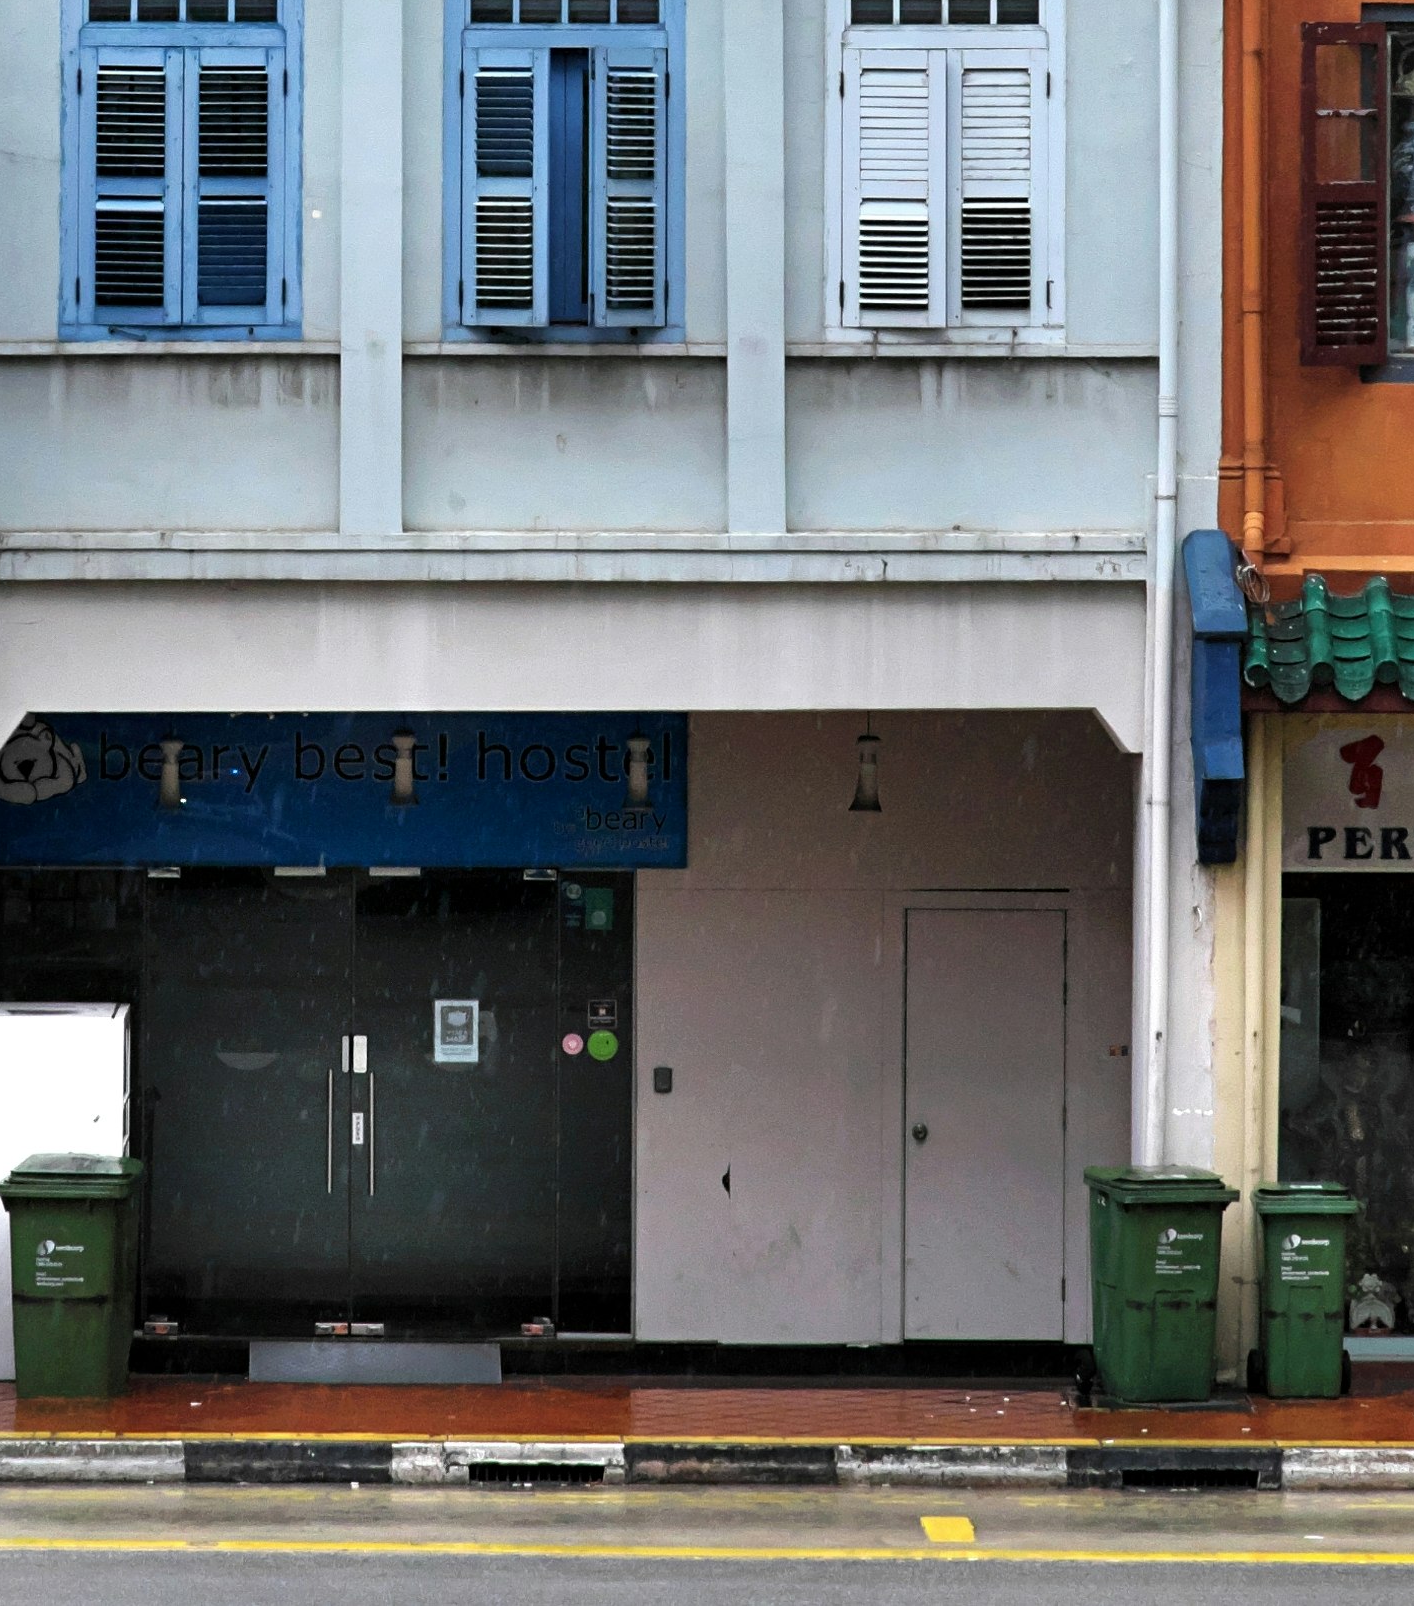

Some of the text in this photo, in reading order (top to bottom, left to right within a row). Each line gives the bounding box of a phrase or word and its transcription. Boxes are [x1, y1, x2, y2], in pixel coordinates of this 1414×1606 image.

[98, 732, 270, 792] beary
[294, 732, 450, 782] best!
[586, 806, 667, 835] beary
